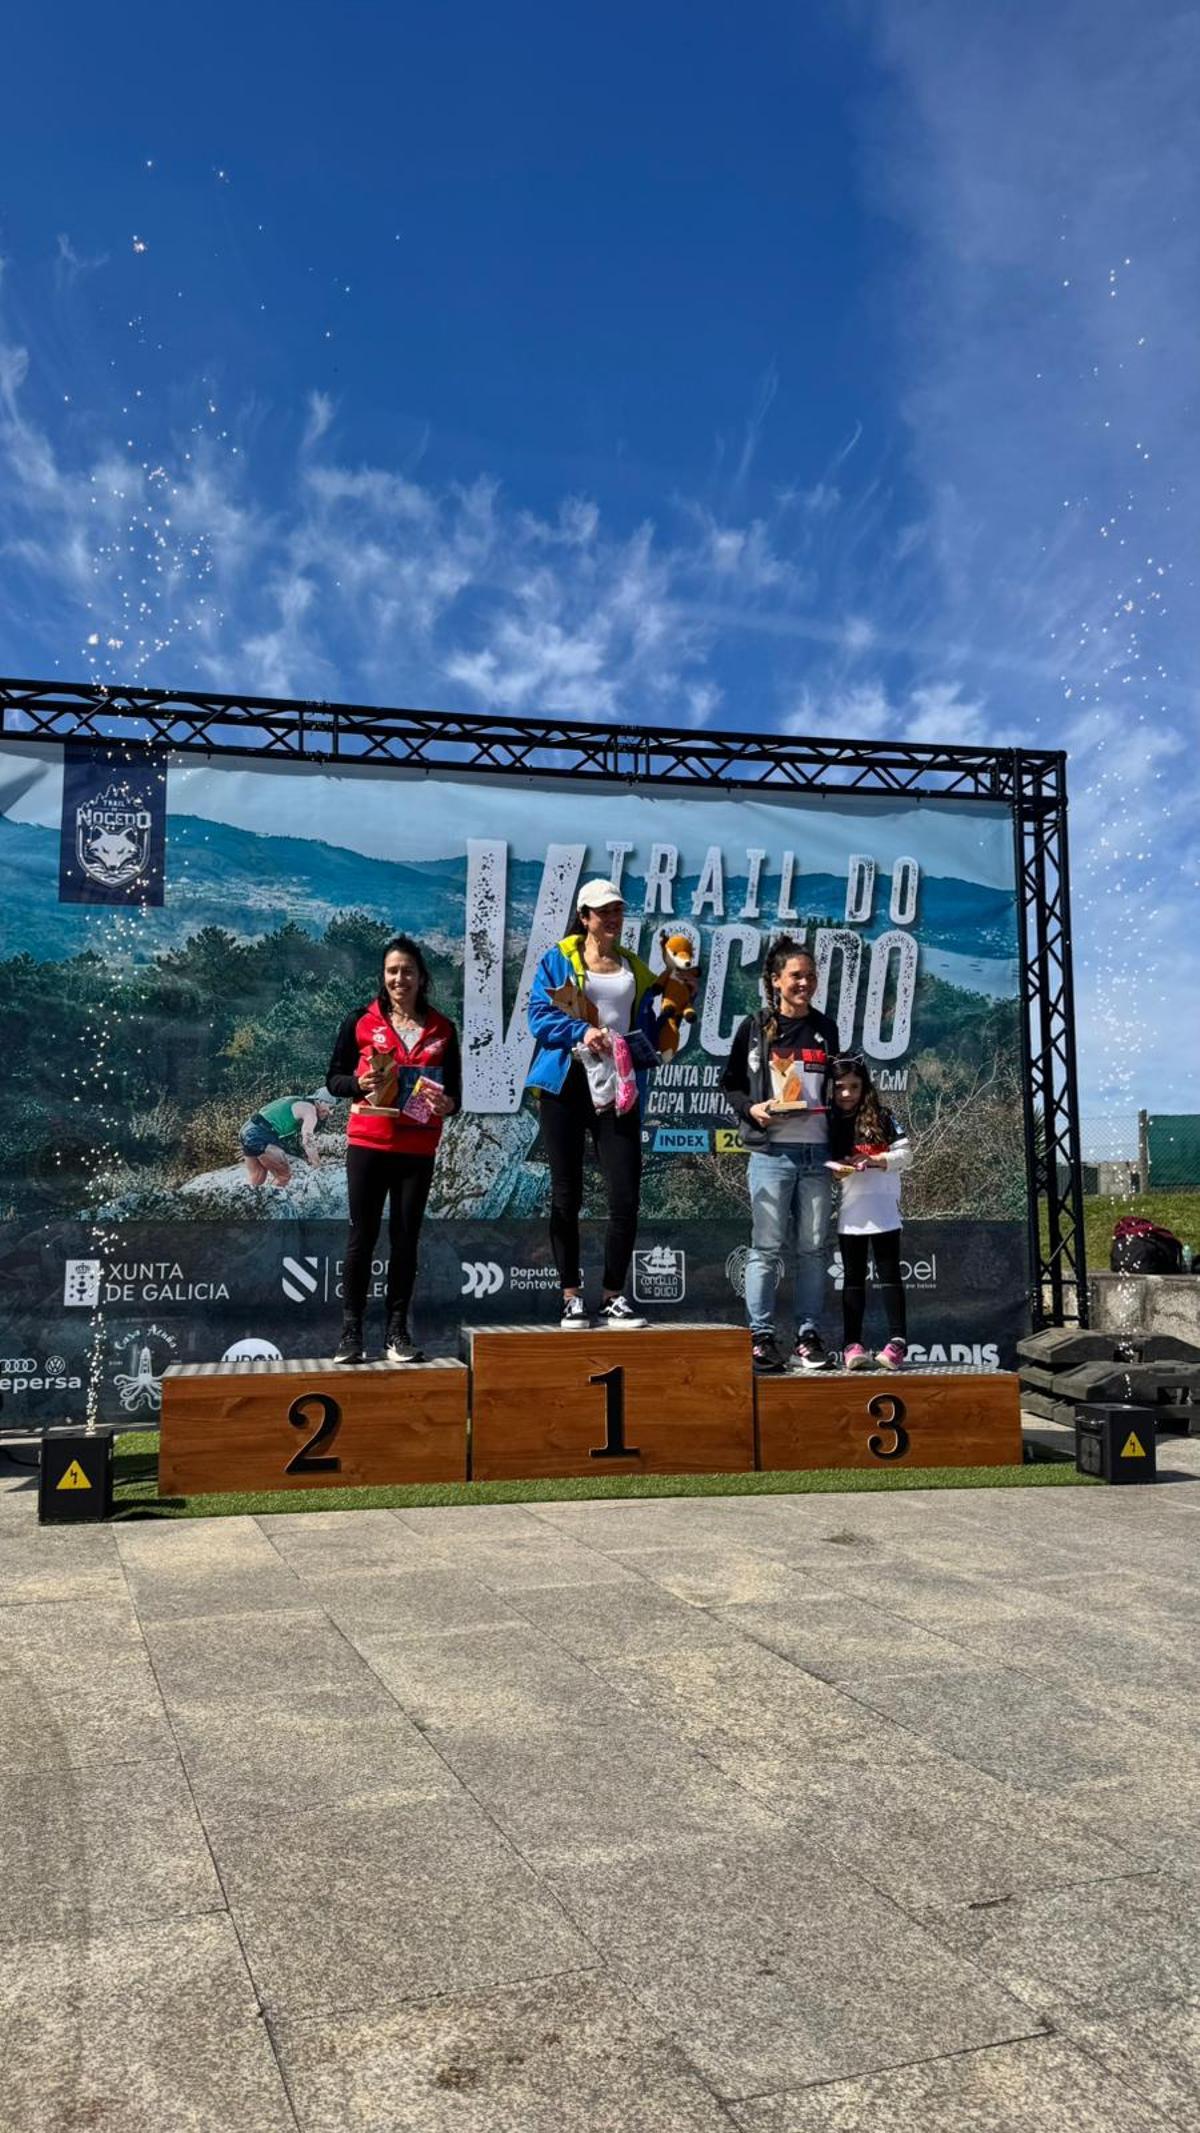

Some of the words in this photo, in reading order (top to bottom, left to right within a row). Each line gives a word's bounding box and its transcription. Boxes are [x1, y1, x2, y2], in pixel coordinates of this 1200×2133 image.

[77, 808, 152, 829] NOCEDO
[606, 841, 799, 920] TRAIL
[845, 854, 919, 925] DO
[653, 1065, 699, 1088] XUNTA
[703, 1066, 721, 1088] DE
[648, 1091, 685, 1114] COPA
[660, 1135, 705, 1148] INDEX
[108, 1262, 184, 1281] XUNTA
[106, 1284, 136, 1302] DE
[142, 1282, 230, 1302] GALICIA
[903, 1343, 1000, 1370] GADIS
[588, 1366, 641, 1459] 1
[284, 1392, 343, 1475] 2
[866, 1393, 910, 1460] 3
